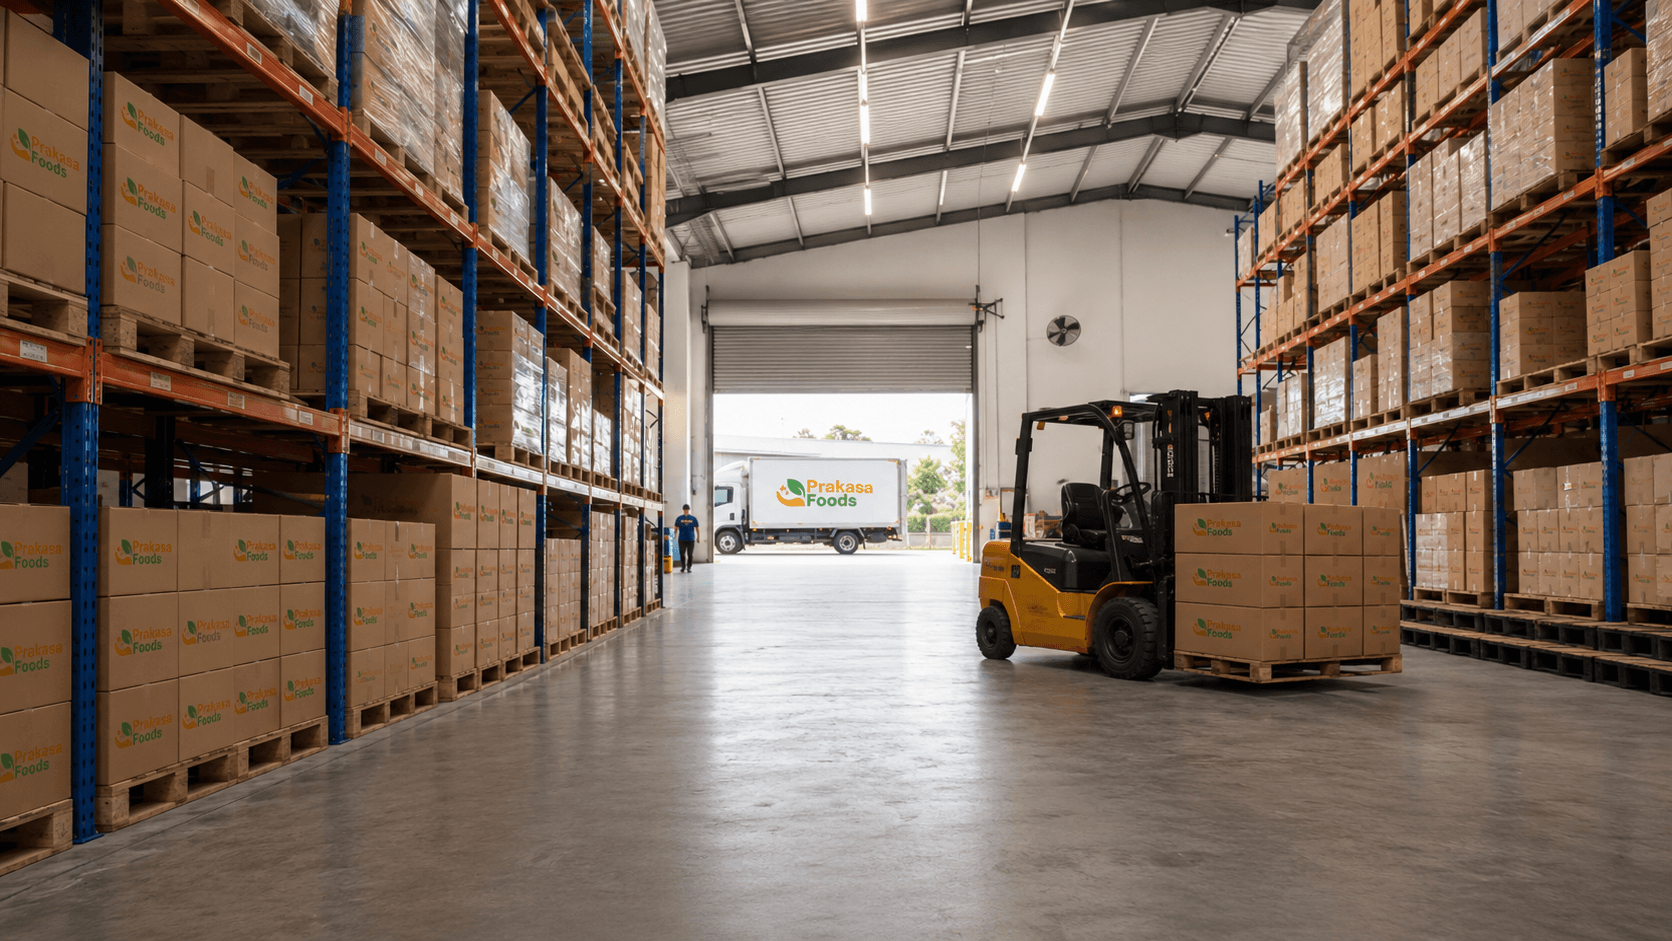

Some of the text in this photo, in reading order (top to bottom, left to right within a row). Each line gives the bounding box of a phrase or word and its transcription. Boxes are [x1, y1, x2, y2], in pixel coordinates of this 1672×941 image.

[137, 121, 166, 146] Foods
[32, 136, 80, 171] Prakasa
[31, 151, 67, 178] Foods
[137, 195, 166, 219] Foods
[201, 226, 224, 246] Foods
[137, 261, 175, 286] Prakasa
[137, 274, 166, 293] Foods
[807, 479, 874, 494] Prakasa
[807, 494, 857, 507] Foods
[1207, 528, 1233, 537] Foods
[14, 542, 62, 555] Prakasa
[132, 540, 172, 553] Prakasa
[246, 541, 276, 551] Prakasa
[14, 556, 49, 569] Foods
[132, 553, 162, 565] Foods
[246, 551, 268, 561] Foods
[294, 551, 314, 560] Foods
[1207, 577, 1233, 588] Foods
[132, 627, 172, 643] Prakasa
[196, 630, 221, 644] Foods
[246, 624, 268, 635] Foods
[1207, 628, 1233, 640] Foods
[15, 642, 63, 659] Prakasa
[132, 639, 162, 654] Foods
[14, 657, 50, 674] Foods
[294, 687, 314, 699] Foods
[246, 699, 268, 713] Foods
[132, 714, 172, 733] Prakasa
[196, 711, 221, 727] Foods
[132, 727, 162, 746] Foods
[14, 744, 62, 763] Prakasa
[14, 759, 49, 779] Foods
